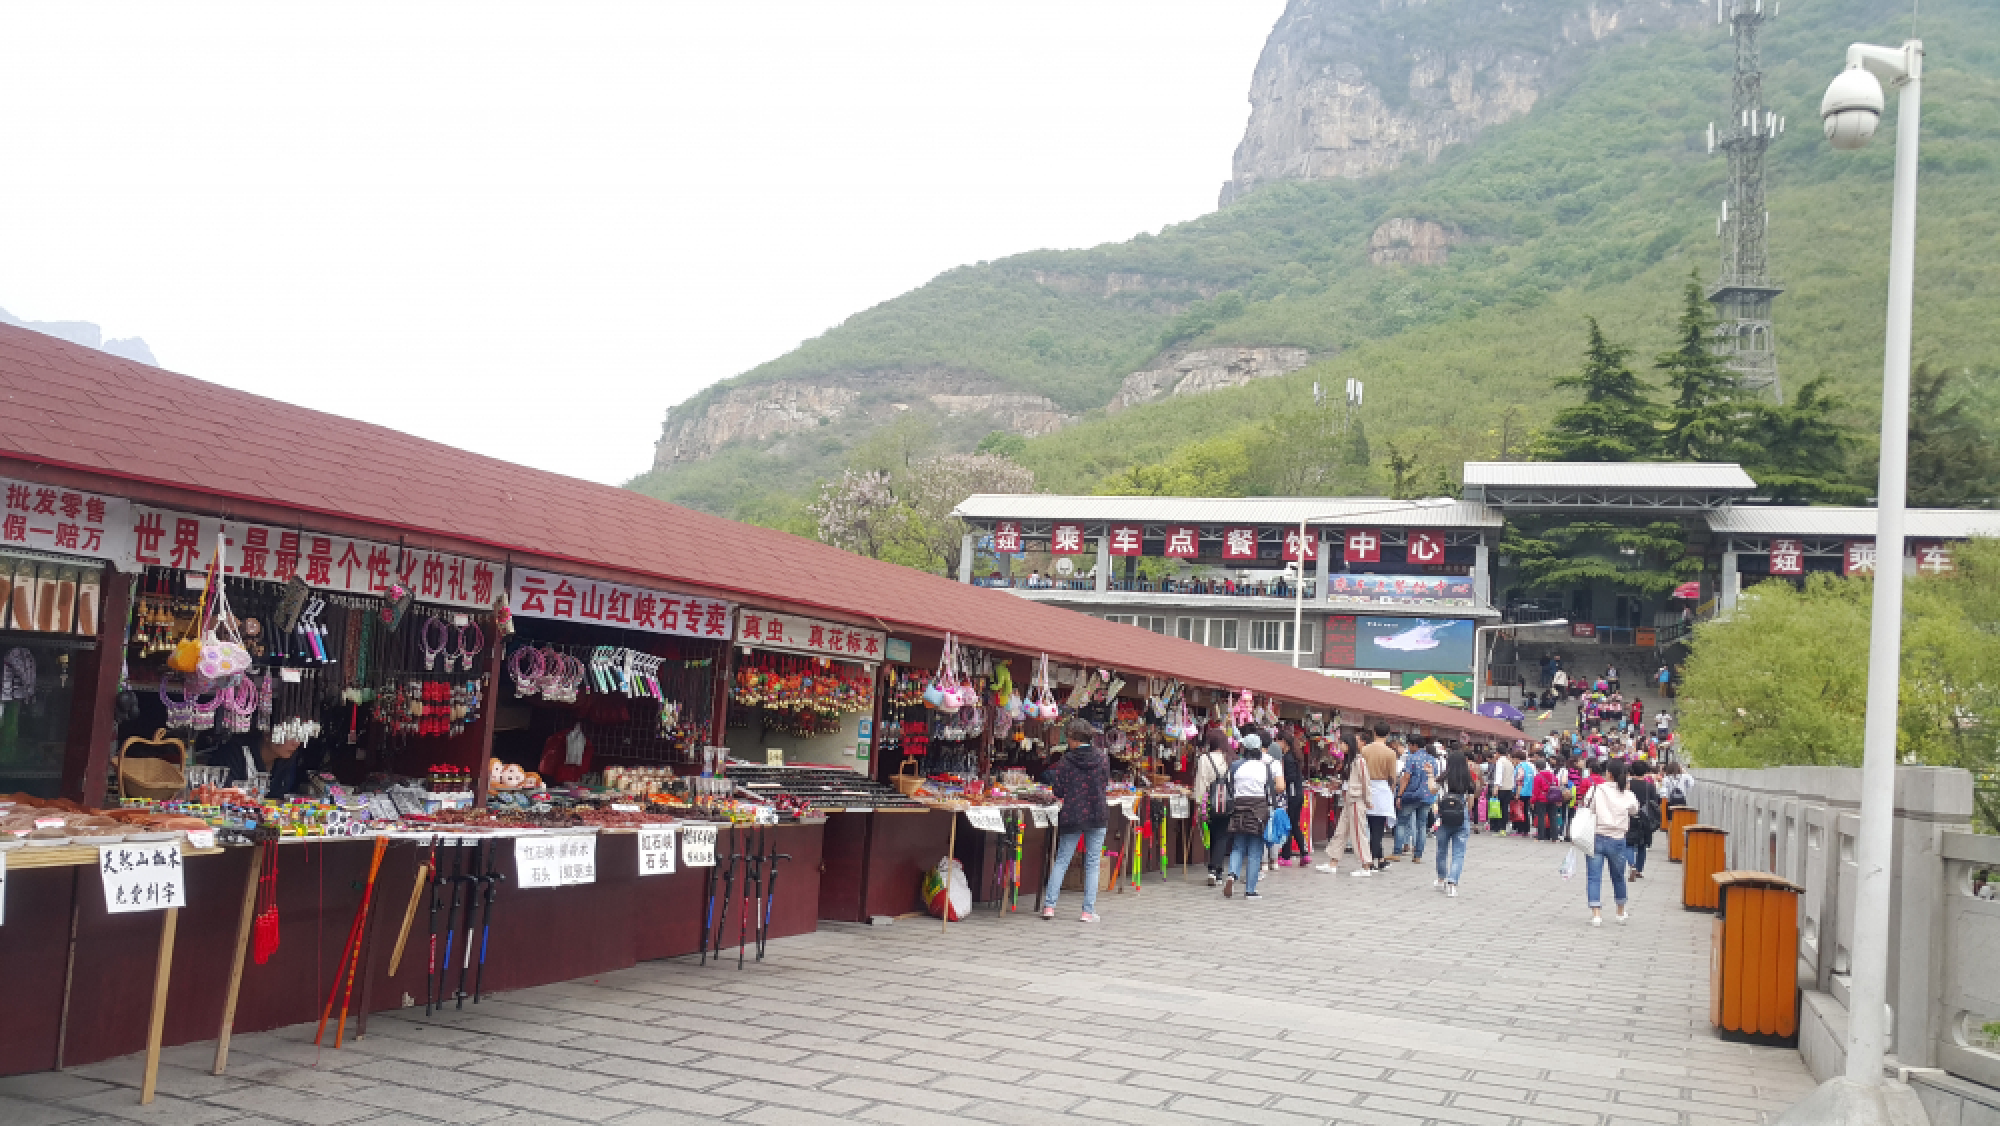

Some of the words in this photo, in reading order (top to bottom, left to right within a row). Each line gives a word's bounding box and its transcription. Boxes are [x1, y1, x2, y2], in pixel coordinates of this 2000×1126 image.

[6, 482, 106, 524] 批发零售
[2, 513, 104, 552] 假一赔万
[520, 576, 726, 637] 云台山红峡石专卖
[741, 614, 879, 656] 真虫、真花标本
